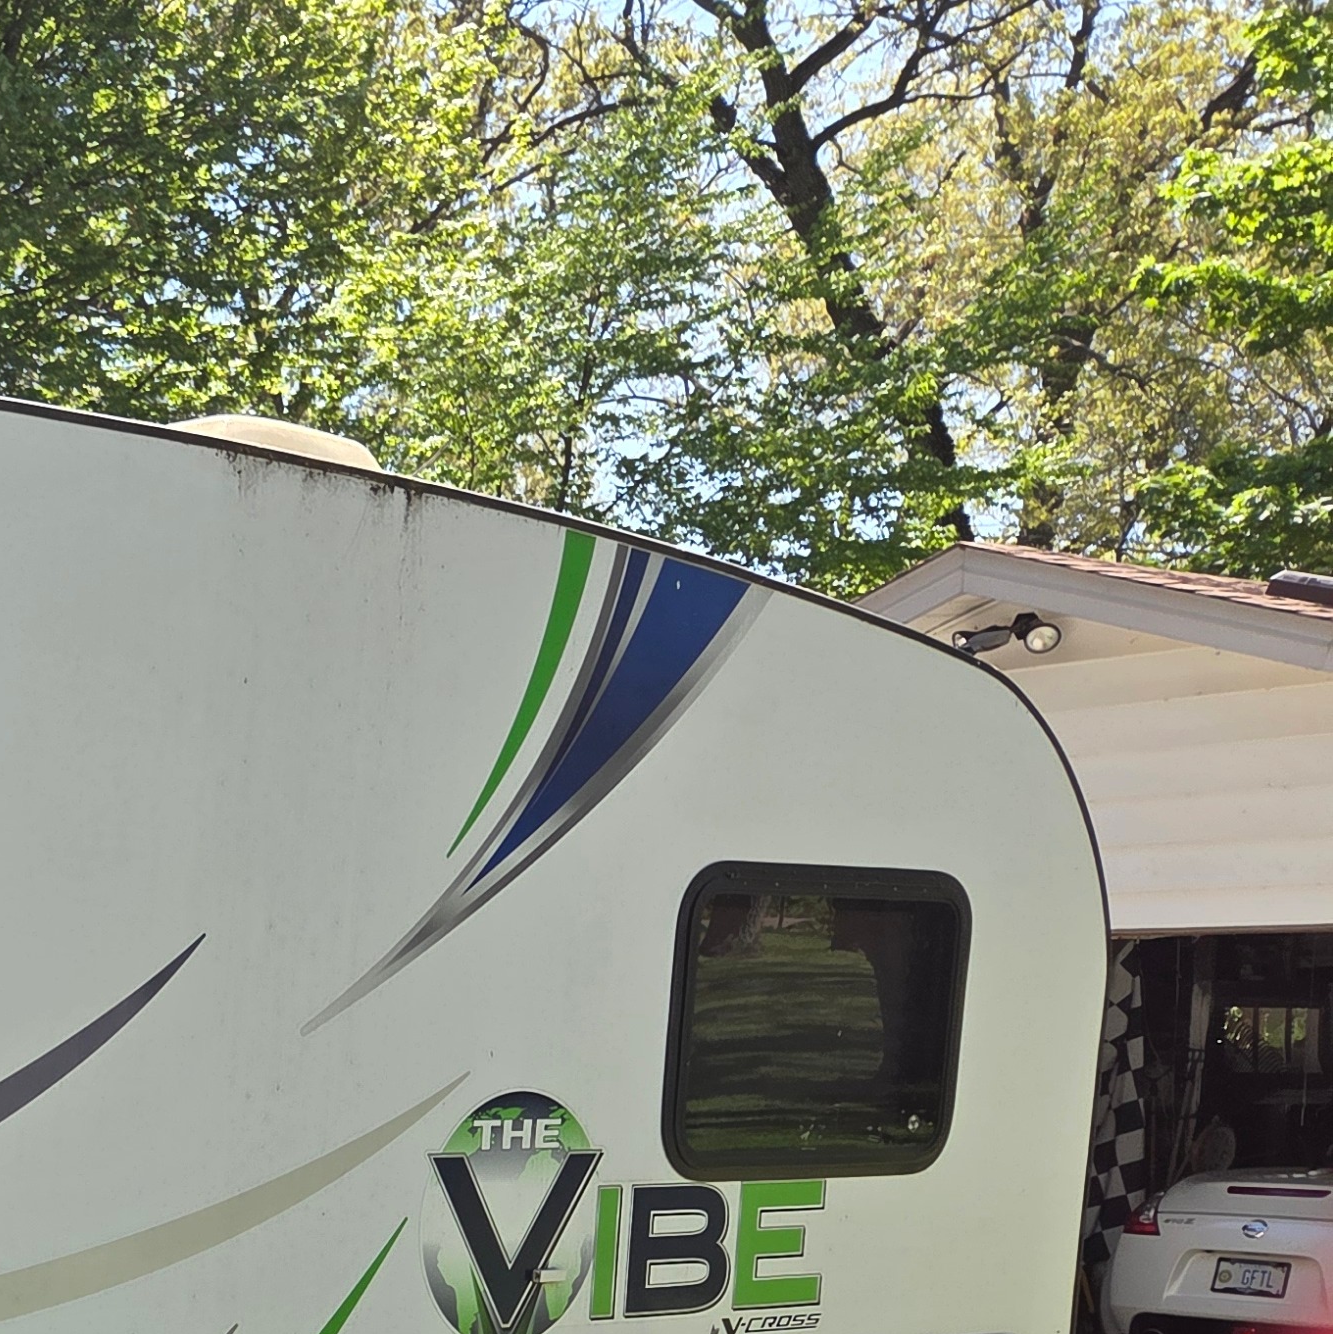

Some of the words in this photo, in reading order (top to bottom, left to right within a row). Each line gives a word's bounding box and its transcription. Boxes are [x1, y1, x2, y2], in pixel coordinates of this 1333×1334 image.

[473, 1117, 562, 1151] THE
[428, 1151, 826, 1330] VIBE
[1242, 1269, 1273, 1288] GFTL
